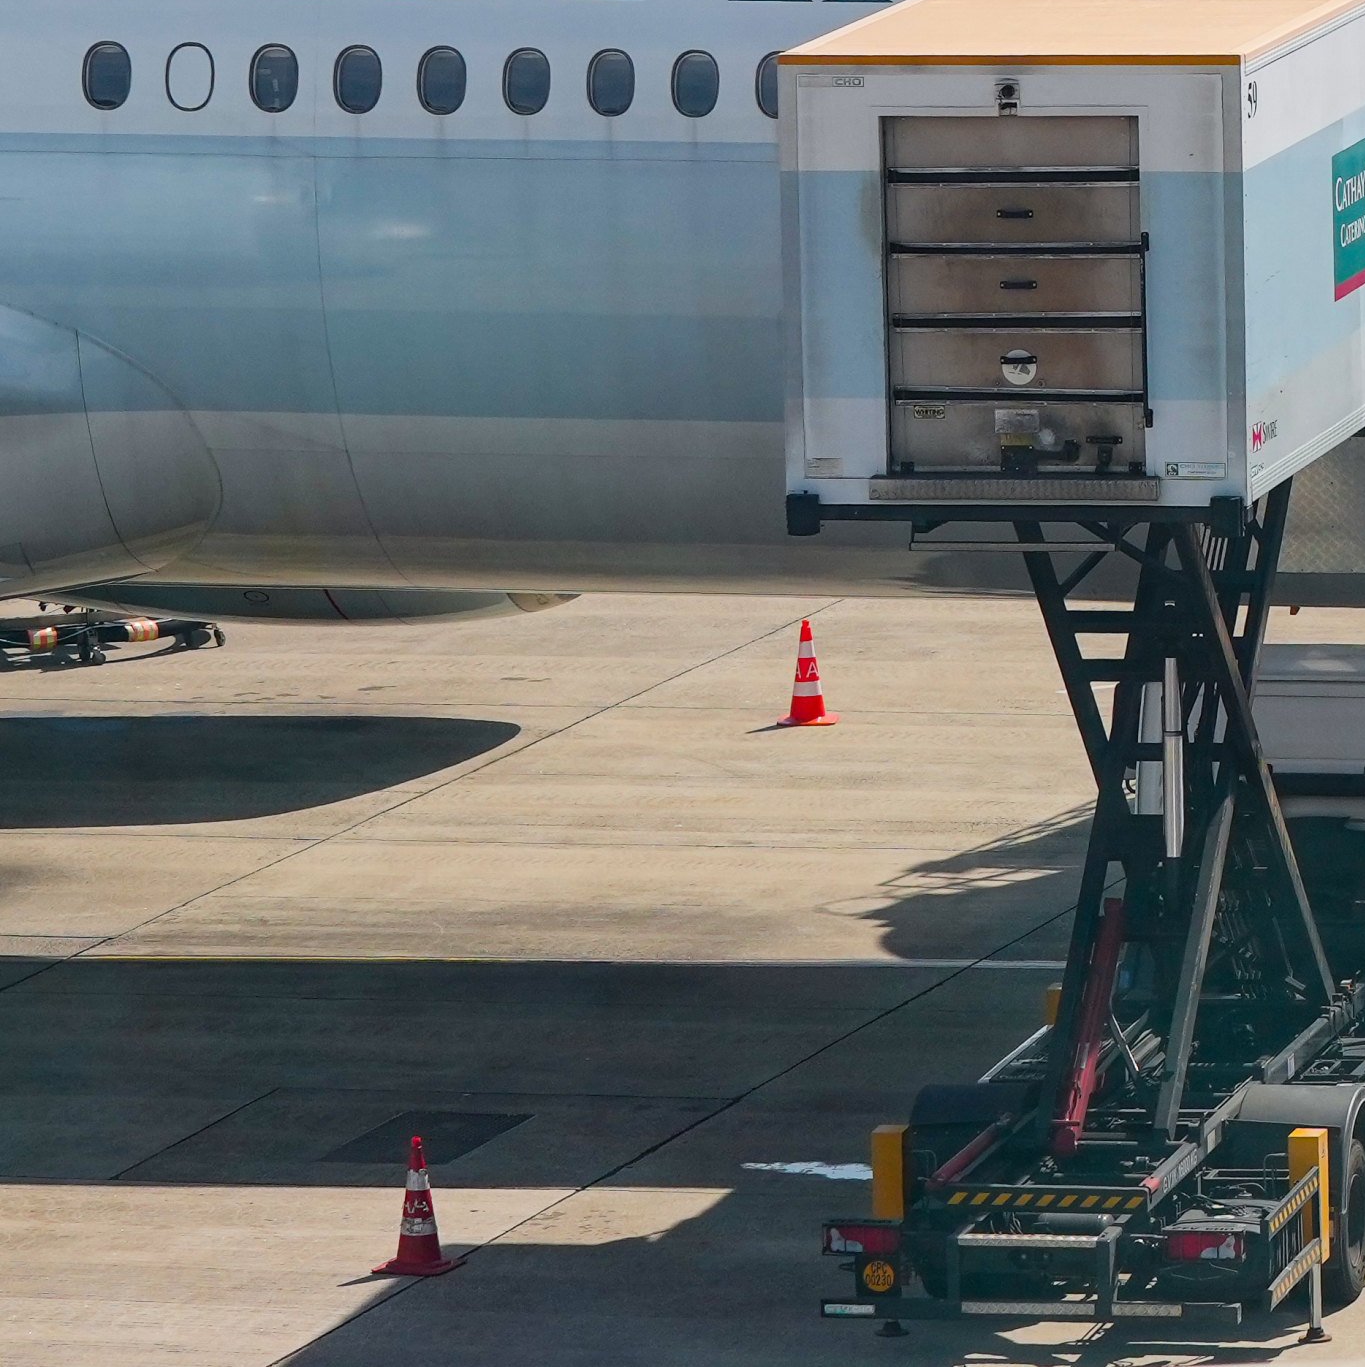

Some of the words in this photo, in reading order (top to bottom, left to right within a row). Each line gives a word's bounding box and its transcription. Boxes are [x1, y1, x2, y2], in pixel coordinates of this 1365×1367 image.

[1247, 80, 1258, 119] 59
[1335, 169, 1365, 212] CATHAY
[870, 1262, 888, 1273] CPC
